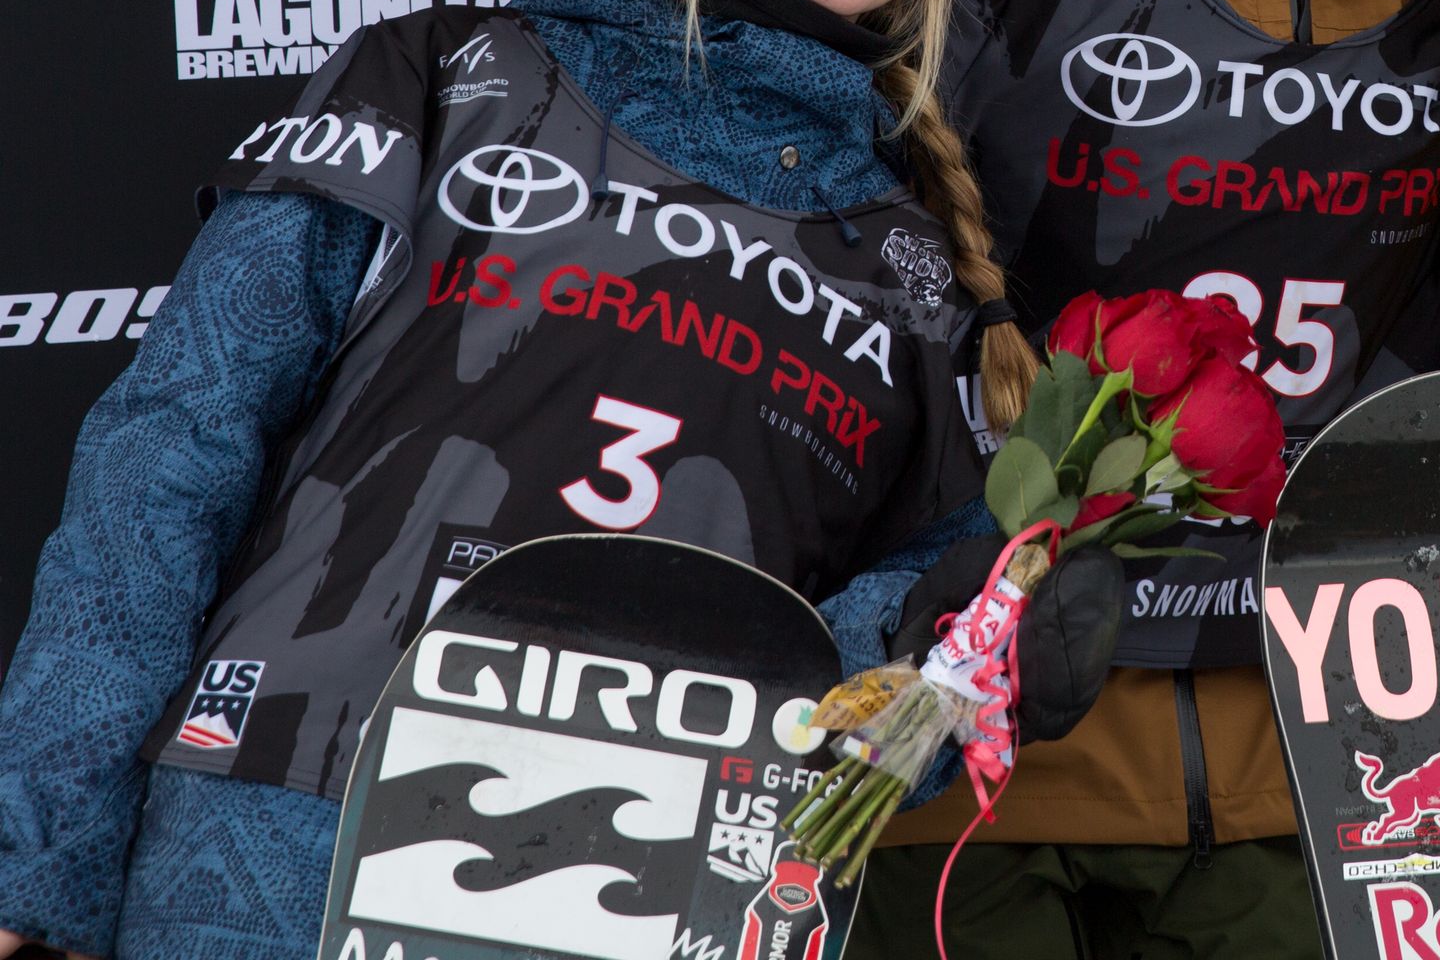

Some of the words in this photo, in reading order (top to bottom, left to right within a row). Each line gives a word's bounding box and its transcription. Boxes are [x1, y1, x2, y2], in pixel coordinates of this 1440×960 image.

[1045, 136, 1151, 200] U.S.
[1166, 154, 1371, 216] GRAND
[427, 253, 522, 312] U.S.
[538, 262, 765, 377] GRAND
[606, 180, 895, 389] TOYOTA
[559, 392, 684, 533] 3
[759, 404, 860, 495] SNOWBOARDING
[1132, 576, 1261, 618] SNOWMA
[202, 662, 262, 694] US
[412, 629, 758, 749] GIRO
[714, 788, 780, 831] US
